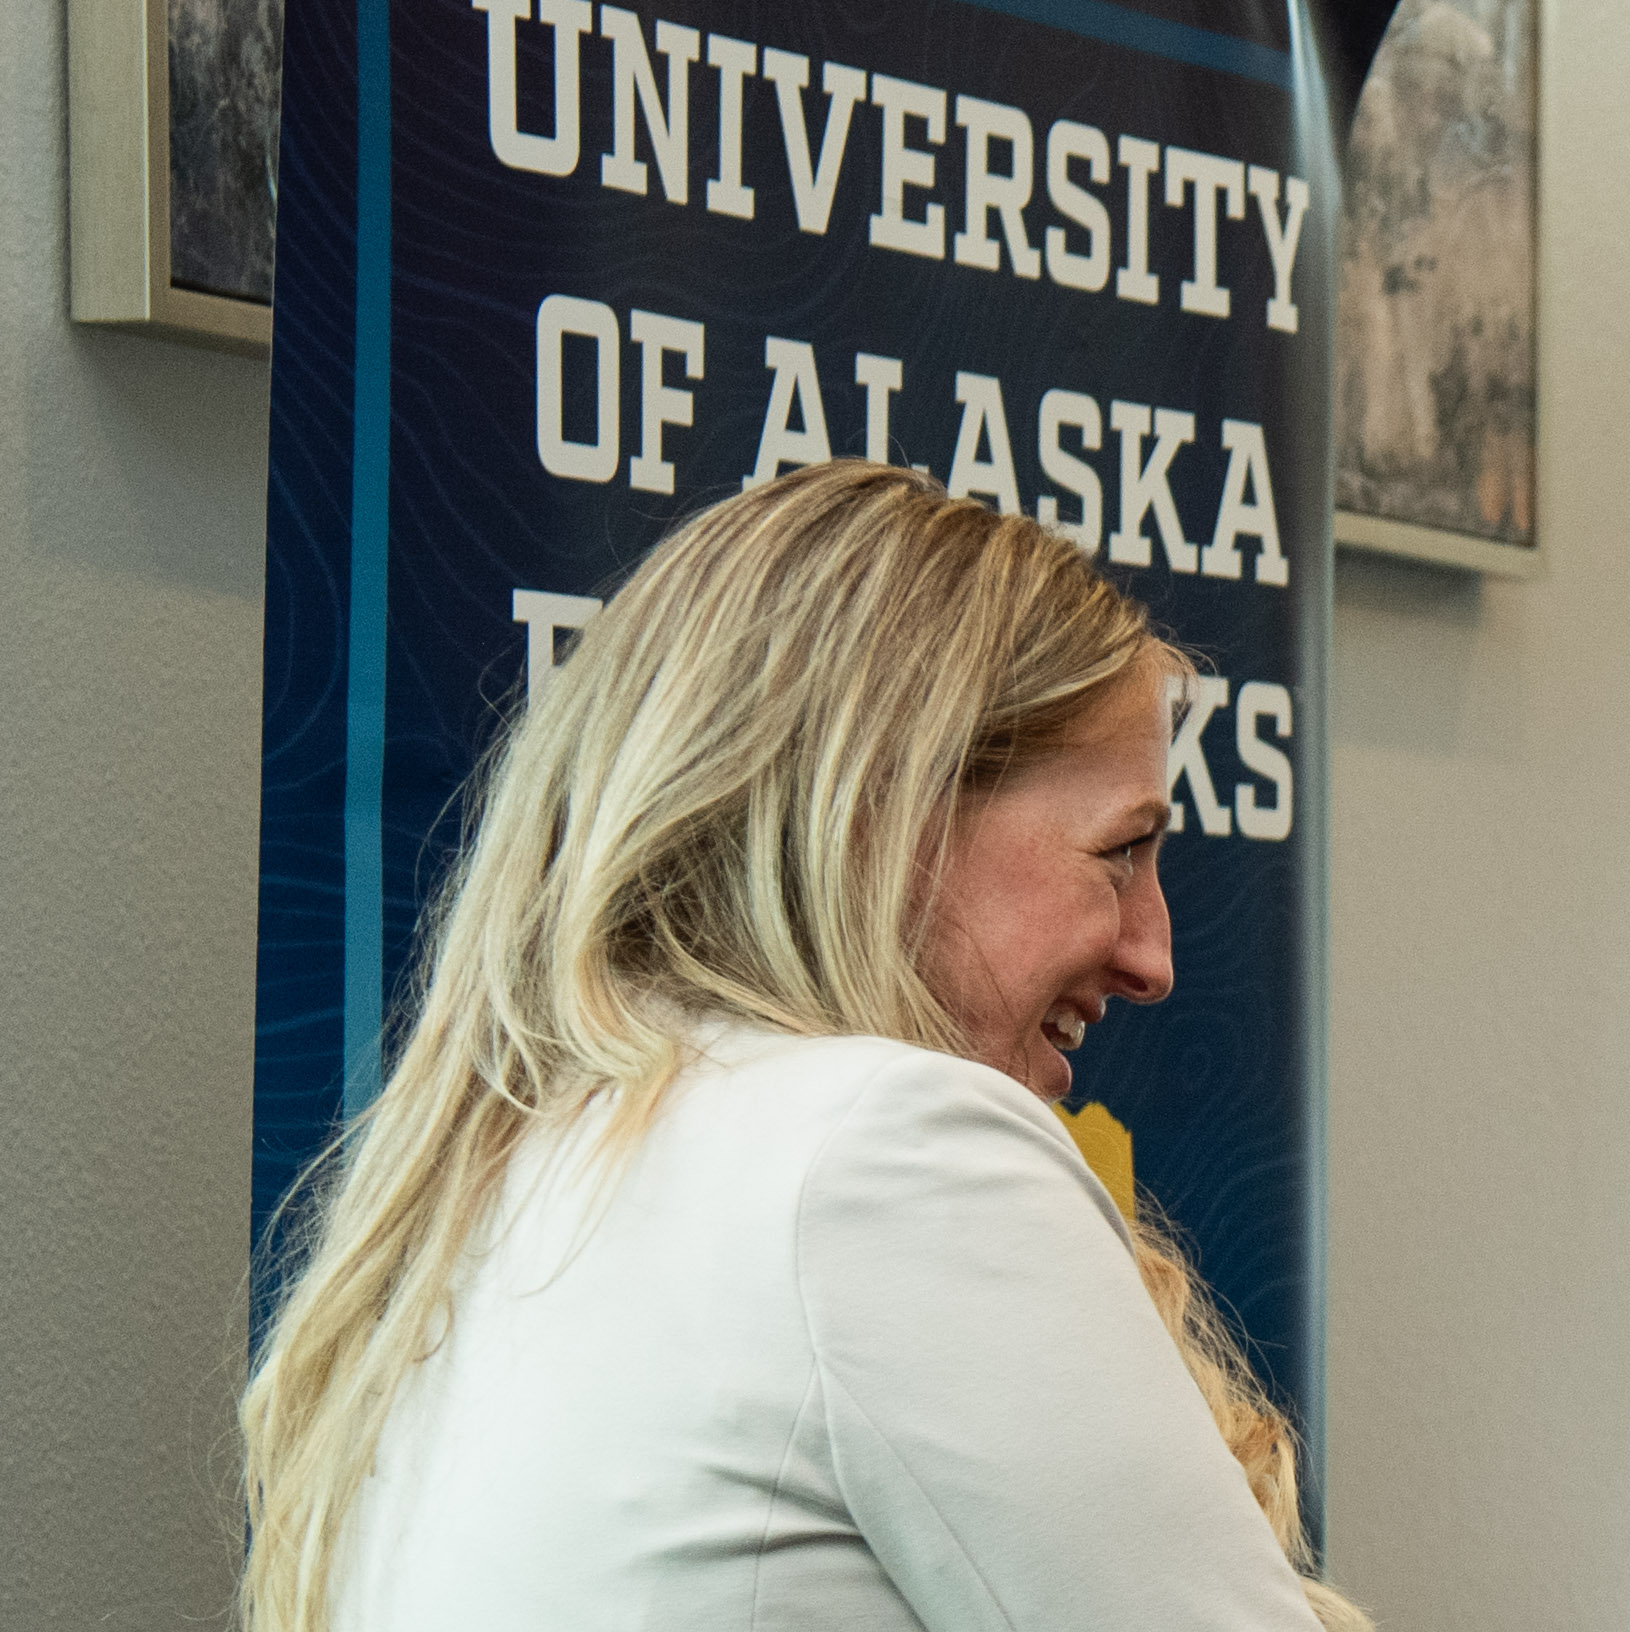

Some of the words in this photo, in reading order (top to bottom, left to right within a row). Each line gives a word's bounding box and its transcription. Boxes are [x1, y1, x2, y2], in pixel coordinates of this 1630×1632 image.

[470, 0, 1310, 334] UNIVERSITY
[535, 293, 705, 496] OF
[742, 335, 1290, 588] ALASKA
